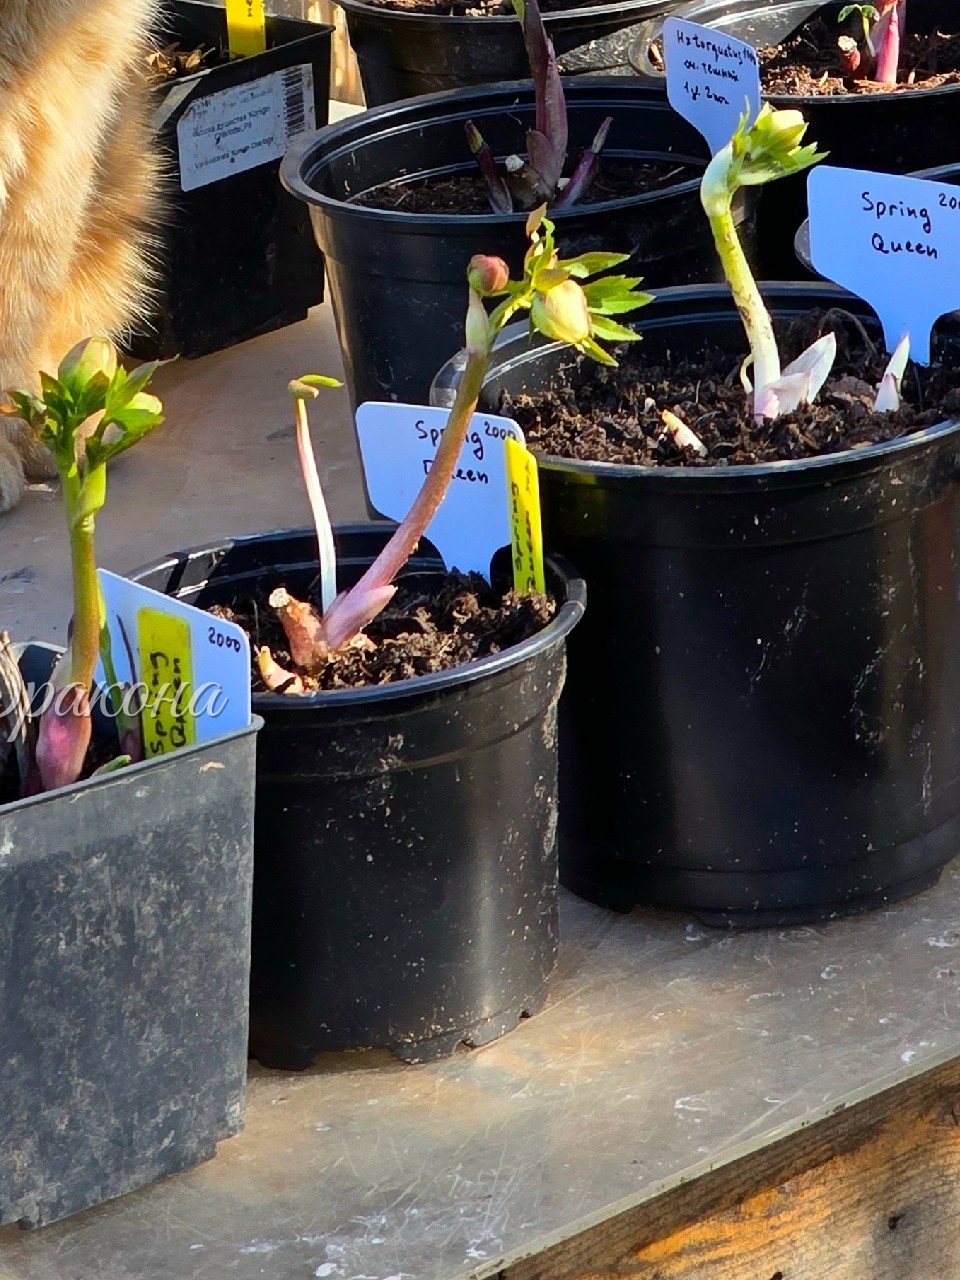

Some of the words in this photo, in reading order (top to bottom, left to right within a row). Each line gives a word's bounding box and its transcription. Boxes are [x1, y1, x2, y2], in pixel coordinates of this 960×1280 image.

[862, 191, 931, 234] Spring
[871, 232, 938, 260] Queen
[414, 419, 485, 461] Sprg
[207, 626, 242, 653] 2000
